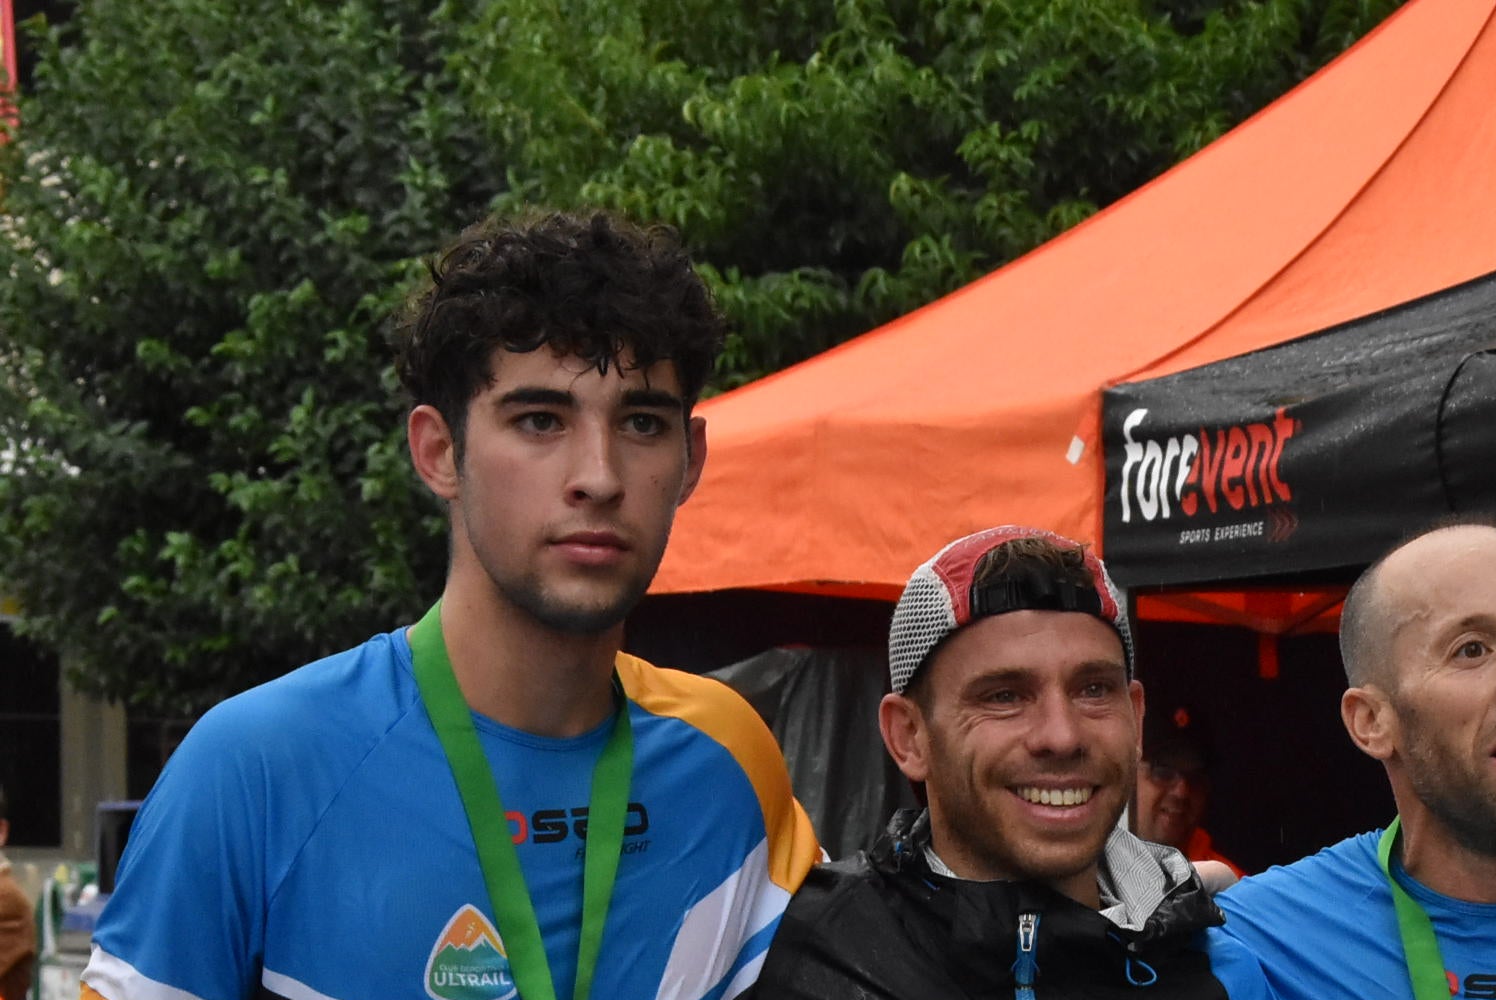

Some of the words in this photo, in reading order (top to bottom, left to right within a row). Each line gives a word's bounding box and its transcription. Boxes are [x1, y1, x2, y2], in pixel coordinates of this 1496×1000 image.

[1120, 406, 1294, 524] forevent
[1179, 528, 1211, 545] SPORTS
[1214, 521, 1264, 541] EXPERIENCE
[433, 971, 511, 987] ULTRAIL
